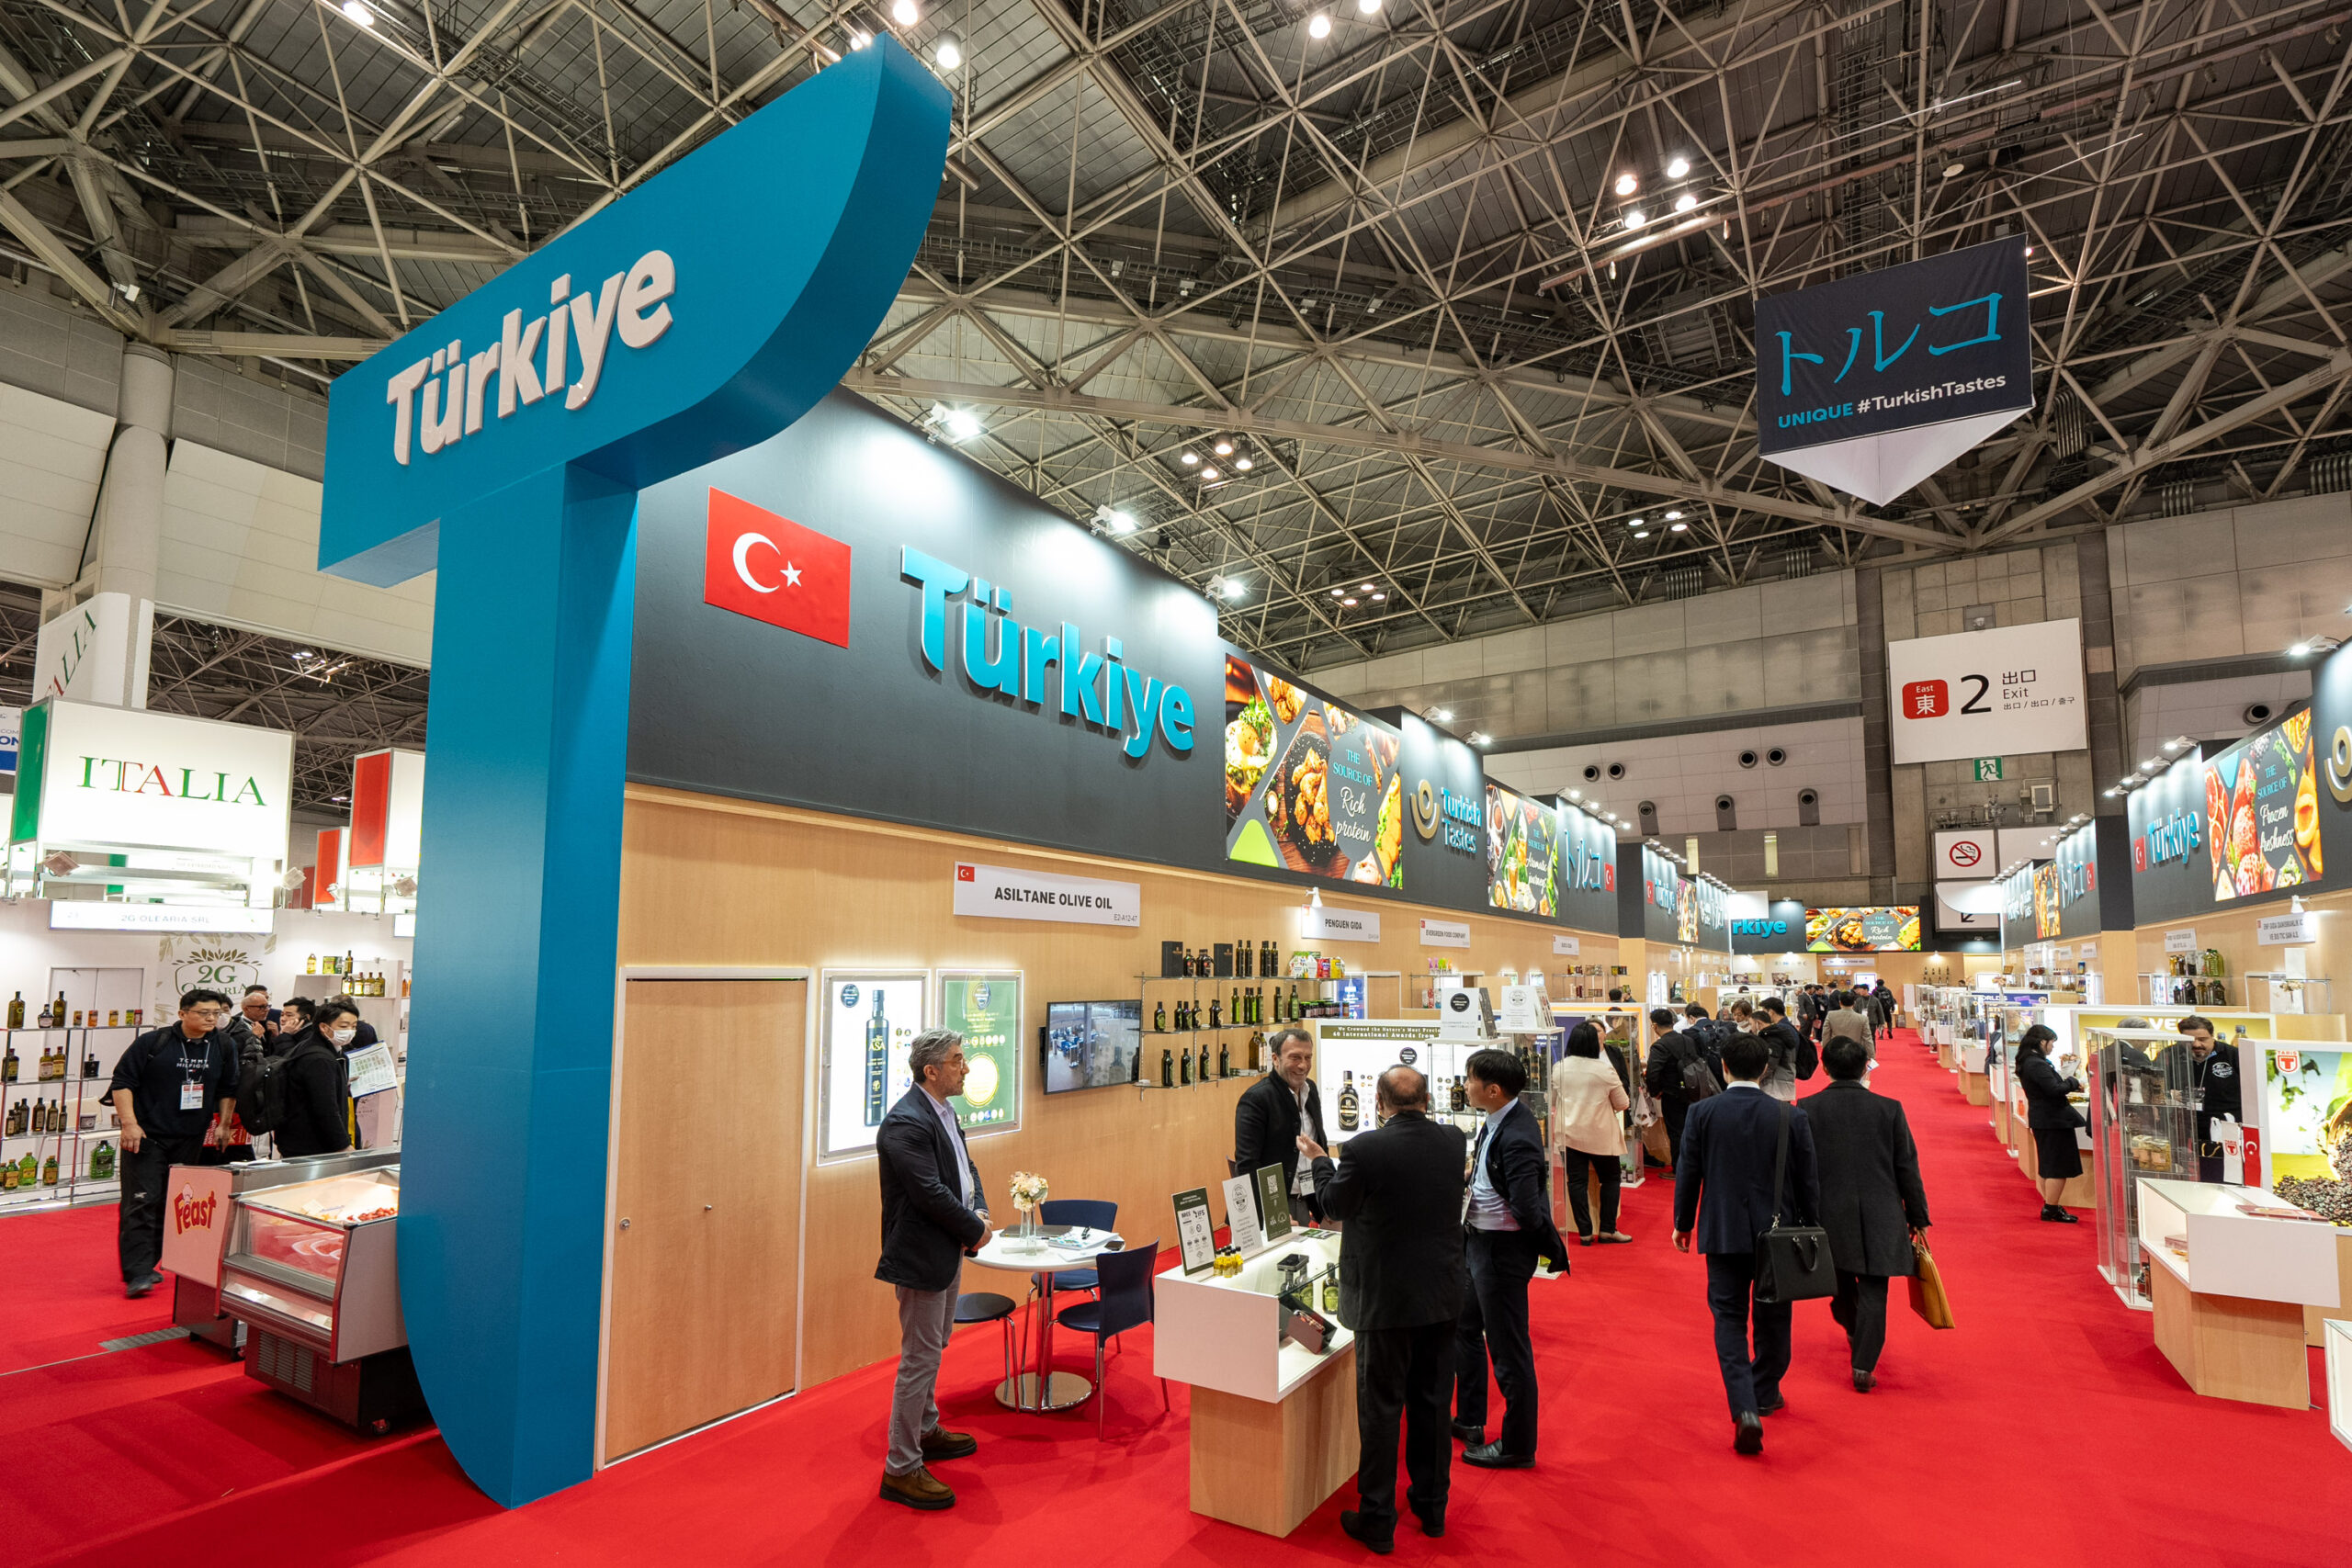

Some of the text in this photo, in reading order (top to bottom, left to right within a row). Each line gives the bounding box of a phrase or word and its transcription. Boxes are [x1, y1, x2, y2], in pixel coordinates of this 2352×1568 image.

[1775, 292, 2003, 396] トルコ
[386, 249, 676, 467] Türkiye
[1778, 375, 2007, 428] UNIQUE #TurkishTastes
[901, 544, 1195, 759] Türkiye
[1916, 684, 1934, 694] East
[2002, 670, 2036, 685] 出口
[1915, 694, 1936, 715] 東
[1961, 674, 1992, 715] 2
[2003, 687, 2029, 700] Exit
[2058, 696, 2075, 705] 출구
[1346, 750, 1360, 765] THE
[76, 756, 267, 807] ITALIA
[1333, 761, 1373, 786] SOURCE OF
[2265, 764, 2277, 778] THE
[2257, 776, 2287, 799] SOURCE OF
[1340, 786, 1366, 818] Rich
[1441, 786, 1482, 827] Turkish
[2260, 804, 2289, 826] Frozen
[1333, 820, 1371, 846] protein
[1442, 818, 1476, 853] Tastes
[2147, 807, 2200, 863] Türkiye
[1564, 829, 1601, 889] トルコ
[994, 886, 1113, 909] ASILTANE OLIVE OIL
[1325, 919, 1362, 930] PENGUEN GIDA
[1732, 919, 1787, 938] rkiye
[1871, 926, 1889, 934] Rich
[197, 964, 237, 984] 2G
[174, 1190, 217, 1235] Feast
